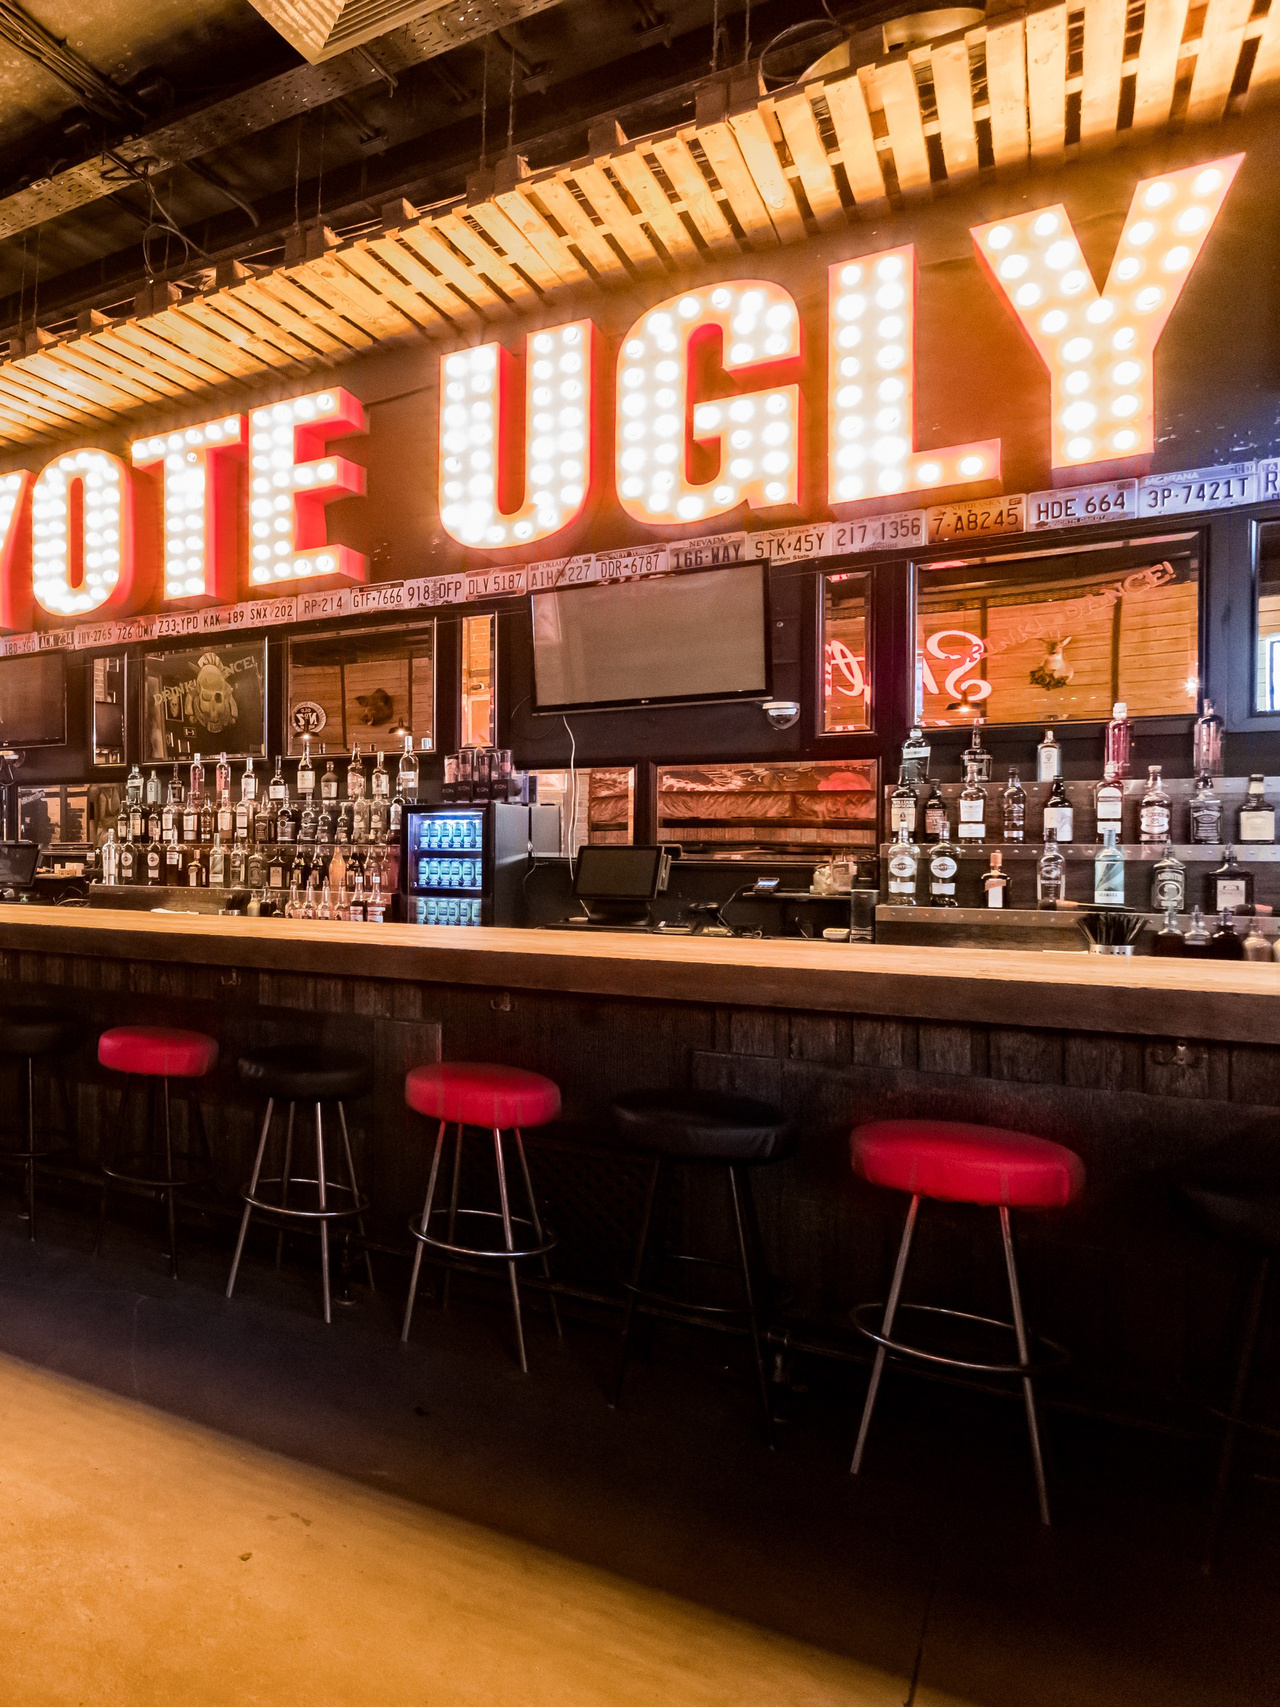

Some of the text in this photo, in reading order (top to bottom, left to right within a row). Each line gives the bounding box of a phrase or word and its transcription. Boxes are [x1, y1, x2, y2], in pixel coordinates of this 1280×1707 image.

[436, 150, 1247, 550] UGLY
[1144, 472, 1200, 486] MONTANA
[1038, 491, 1126, 521] HDE 664
[787, 528, 811, 537] Jersey
[836, 517, 921, 547] 217 1356
[688, 536, 726, 548] NEVADA
[493, 572, 523, 592] 5187
[567, 564, 591, 583] 227
[407, 584, 431, 603] 918
[227, 610, 245, 624] 189
[250, 604, 293, 620] SNX 202
[117, 626, 132, 640] 726
[153, 678, 197, 706] DRINK!
